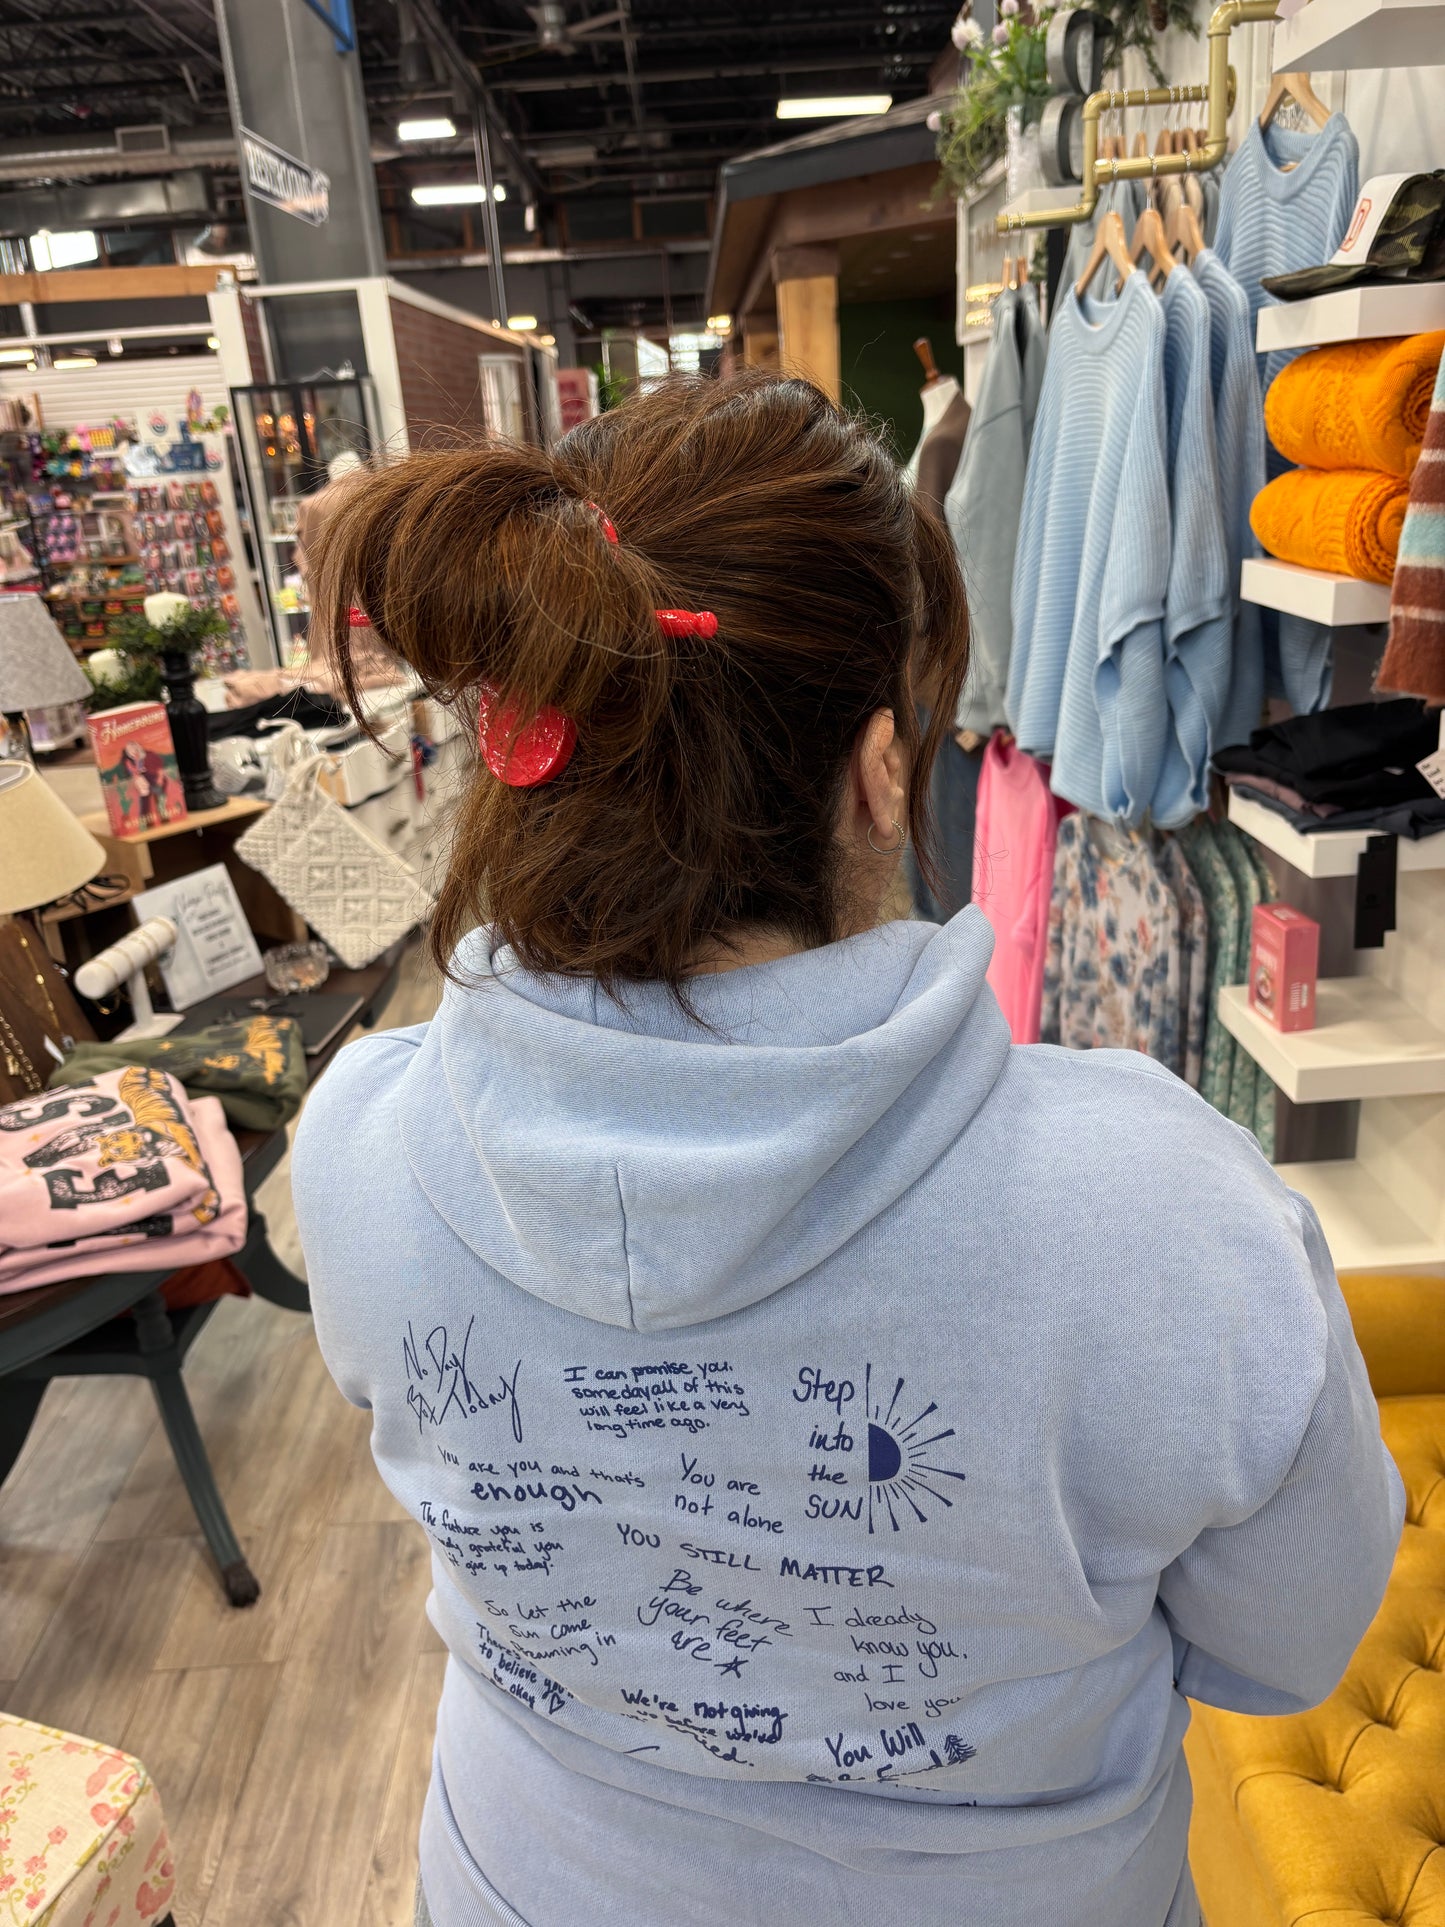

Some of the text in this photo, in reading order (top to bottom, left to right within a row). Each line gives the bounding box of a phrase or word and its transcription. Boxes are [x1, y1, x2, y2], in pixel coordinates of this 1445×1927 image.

[403, 1315, 474, 1404] No Day
[564, 1366, 587, 1381] I
[595, 1369, 627, 1380] can
[631, 1361, 693, 1381] promise
[684, 1377, 699, 1393] of
[705, 1380, 744, 1395] this
[793, 1366, 855, 1415] Step
[439, 1360, 522, 1443] Today
[580, 1398, 750, 1416] will feel like a very
[587, 1418, 710, 1438] long time ago.
[809, 1421, 854, 1452] into
[438, 1445, 645, 1488] You are you and that's
[681, 1452, 761, 1496] You are
[808, 1464, 848, 1484] the
[470, 1482, 603, 1512] enough
[805, 1494, 863, 1520] SUN
[420, 1501, 545, 1540] The future you is
[675, 1494, 784, 1534] not alone
[469, 1538, 526, 1557] grateful
[534, 1541, 564, 1561] you
[617, 1523, 895, 1588] YOU STILL MATTER
[465, 1561, 487, 1576] give
[494, 1563, 508, 1576] up
[484, 1600, 509, 1616] So
[557, 1596, 597, 1613] the
[659, 1569, 794, 1637] Be where
[551, 1619, 591, 1640] come
[638, 1596, 773, 1652] your feet
[803, 1605, 937, 1635] I already
[597, 1632, 616, 1646] in
[671, 1631, 713, 1662] are
[851, 1635, 909, 1657] know
[479, 1642, 493, 1659] to
[498, 1653, 537, 1683] believe
[833, 1665, 905, 1683] and I
[621, 1688, 679, 1712] We're
[864, 1693, 963, 1718] love you
[825, 1722, 926, 1768] You Will
